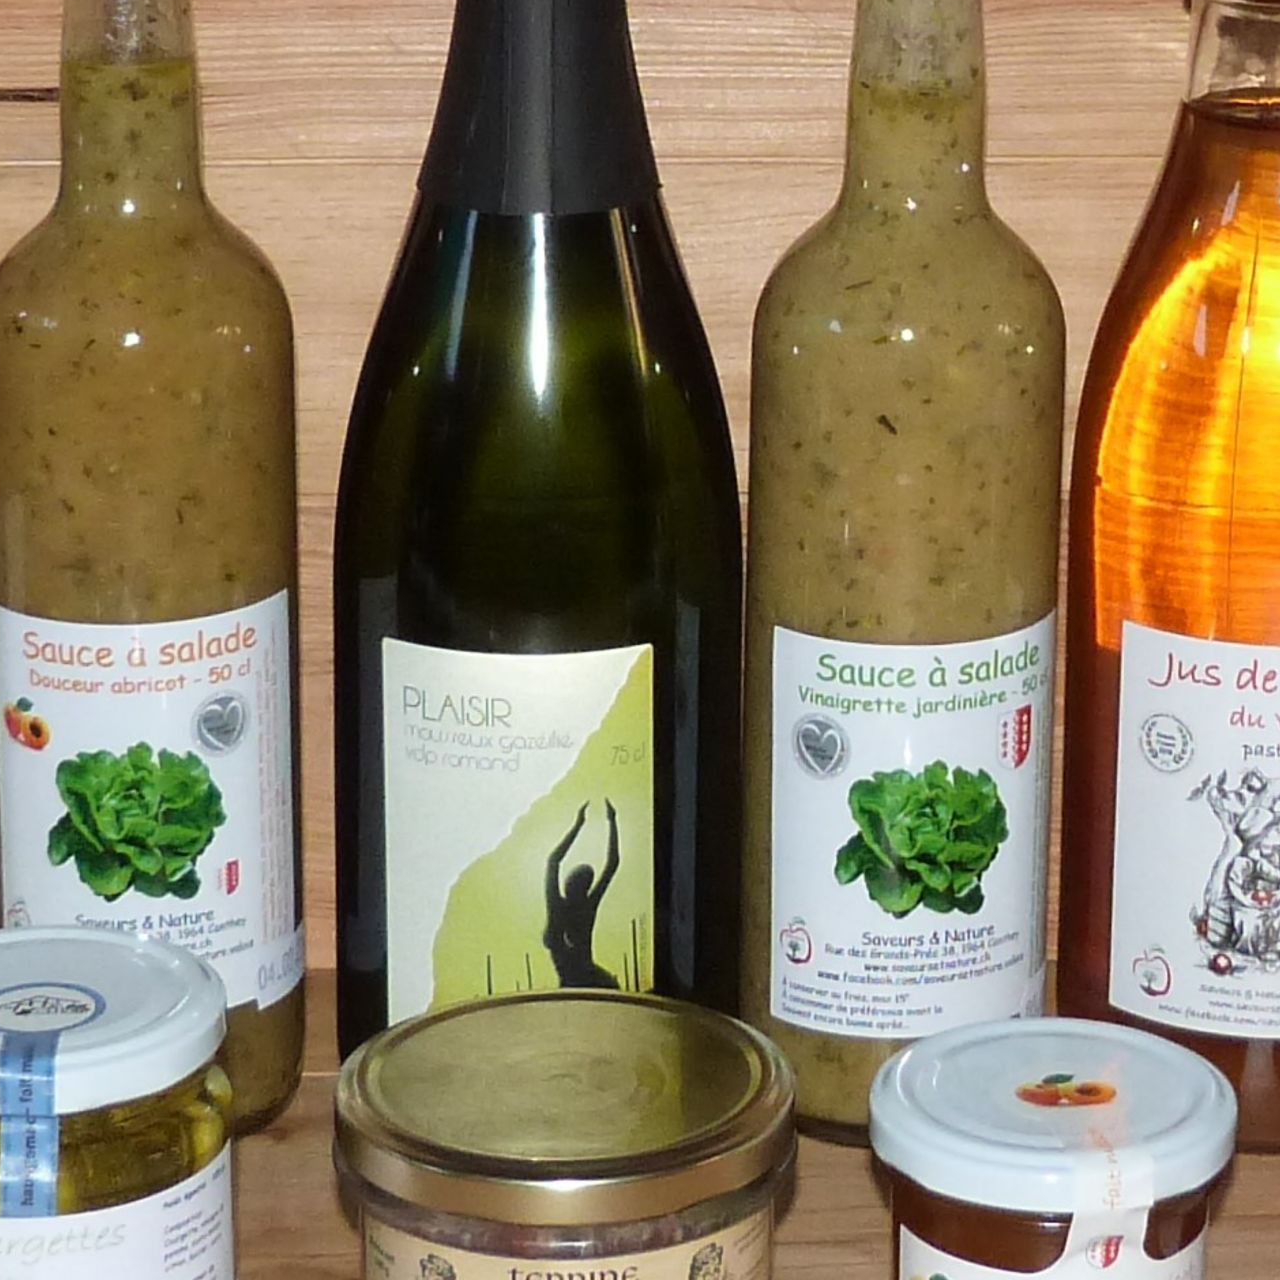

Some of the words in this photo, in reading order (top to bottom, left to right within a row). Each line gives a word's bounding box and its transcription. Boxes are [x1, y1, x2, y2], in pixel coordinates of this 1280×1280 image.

[23, 630, 114, 668] Sauce
[126, 636, 147, 668] à
[158, 622, 258, 666] salade
[29, 668, 104, 693] Douceur
[111, 675, 186, 694] abricot
[208, 665, 233, 685] 50
[816, 653, 916, 688] Sauce
[929, 656, 947, 688] à
[958, 640, 1040, 686] salade
[1148, 652, 1222, 688] Jus
[1236, 659, 1278, 693] de
[402, 685, 512, 728] PLAISIR
[798, 685, 907, 714] Vinaigrette
[913, 688, 1008, 719] jardinière
[1229, 706, 1265, 729] du
[159, 907, 214, 929] Nature
[861, 930, 925, 948] Saveurs
[944, 923, 995, 944] Nature
